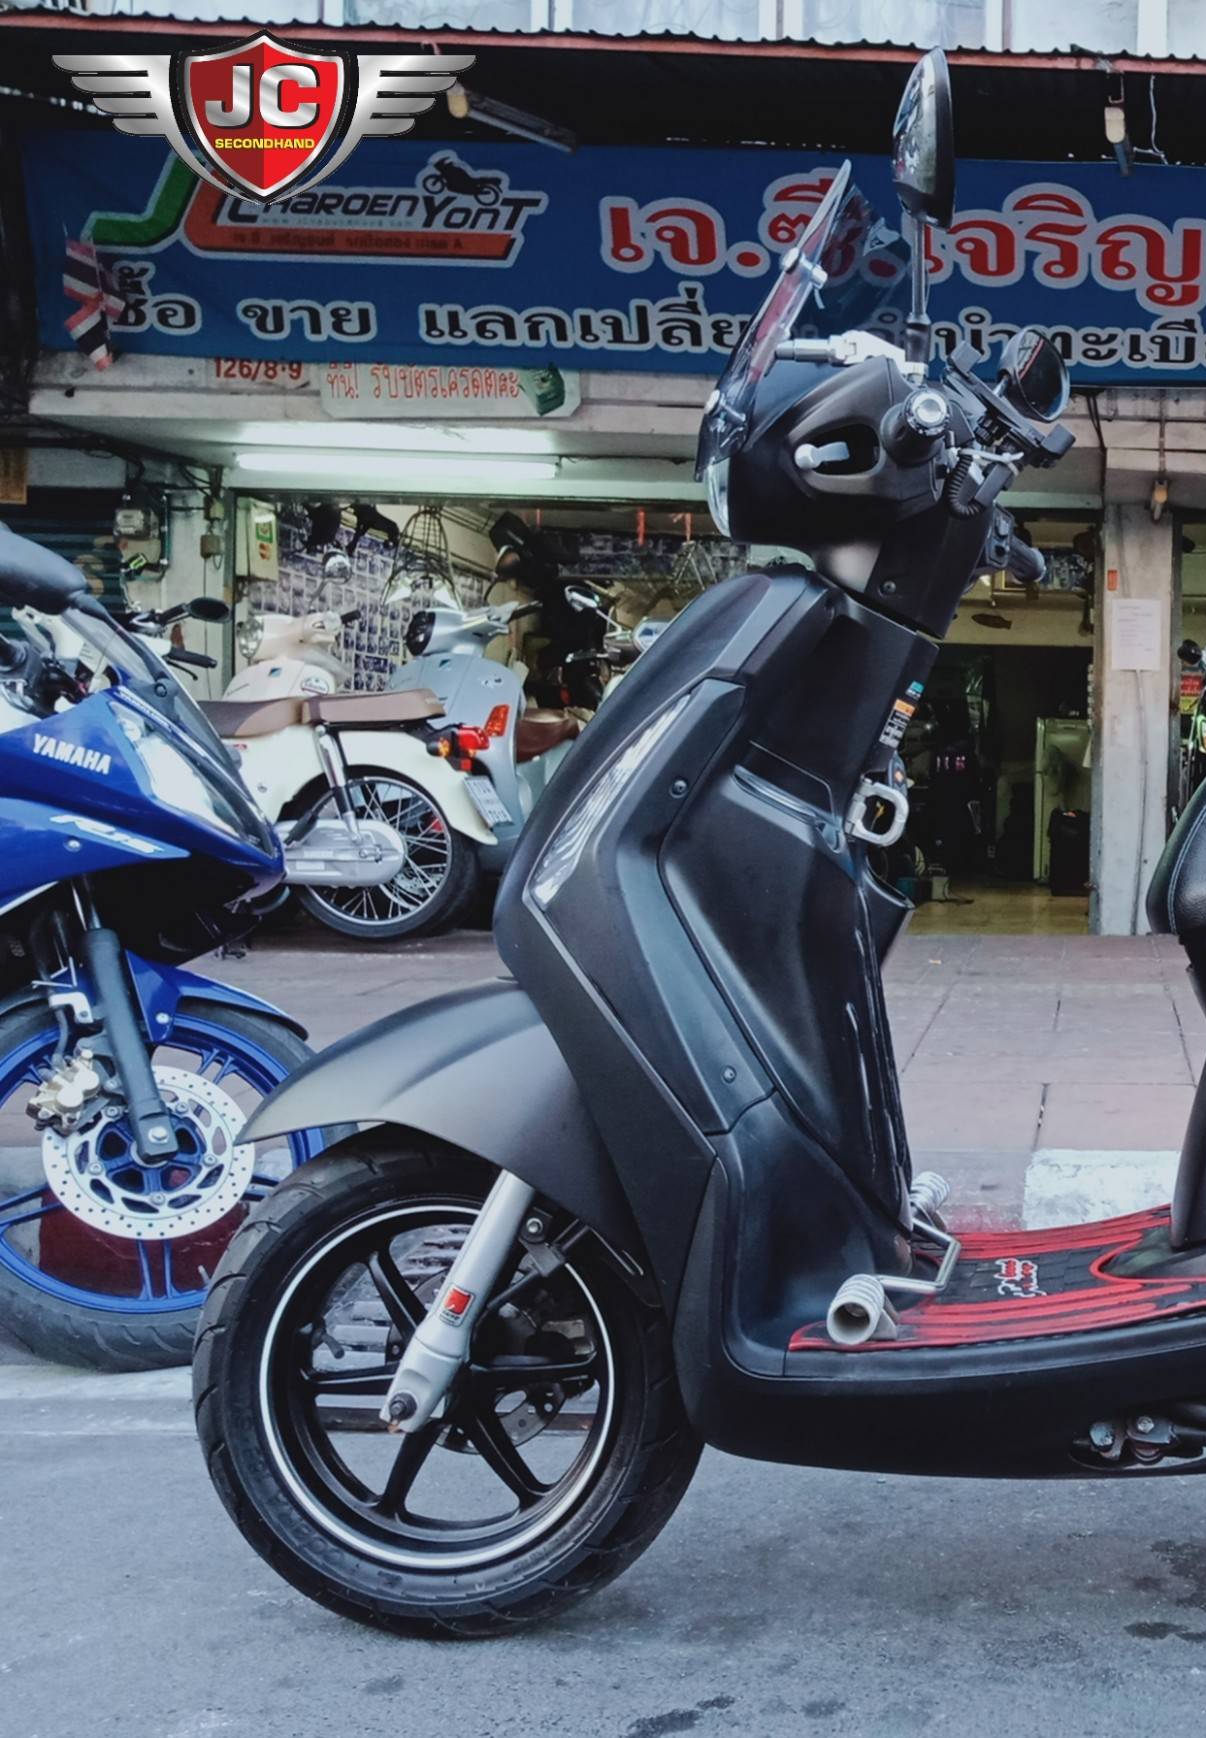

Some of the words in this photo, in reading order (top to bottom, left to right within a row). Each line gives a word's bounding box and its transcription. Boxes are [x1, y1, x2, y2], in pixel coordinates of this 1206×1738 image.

[240, 303, 372, 337] ขาย
[424, 287, 747, 349] แลกเปลี่ย
[32, 732, 112, 776] YAMAHA
